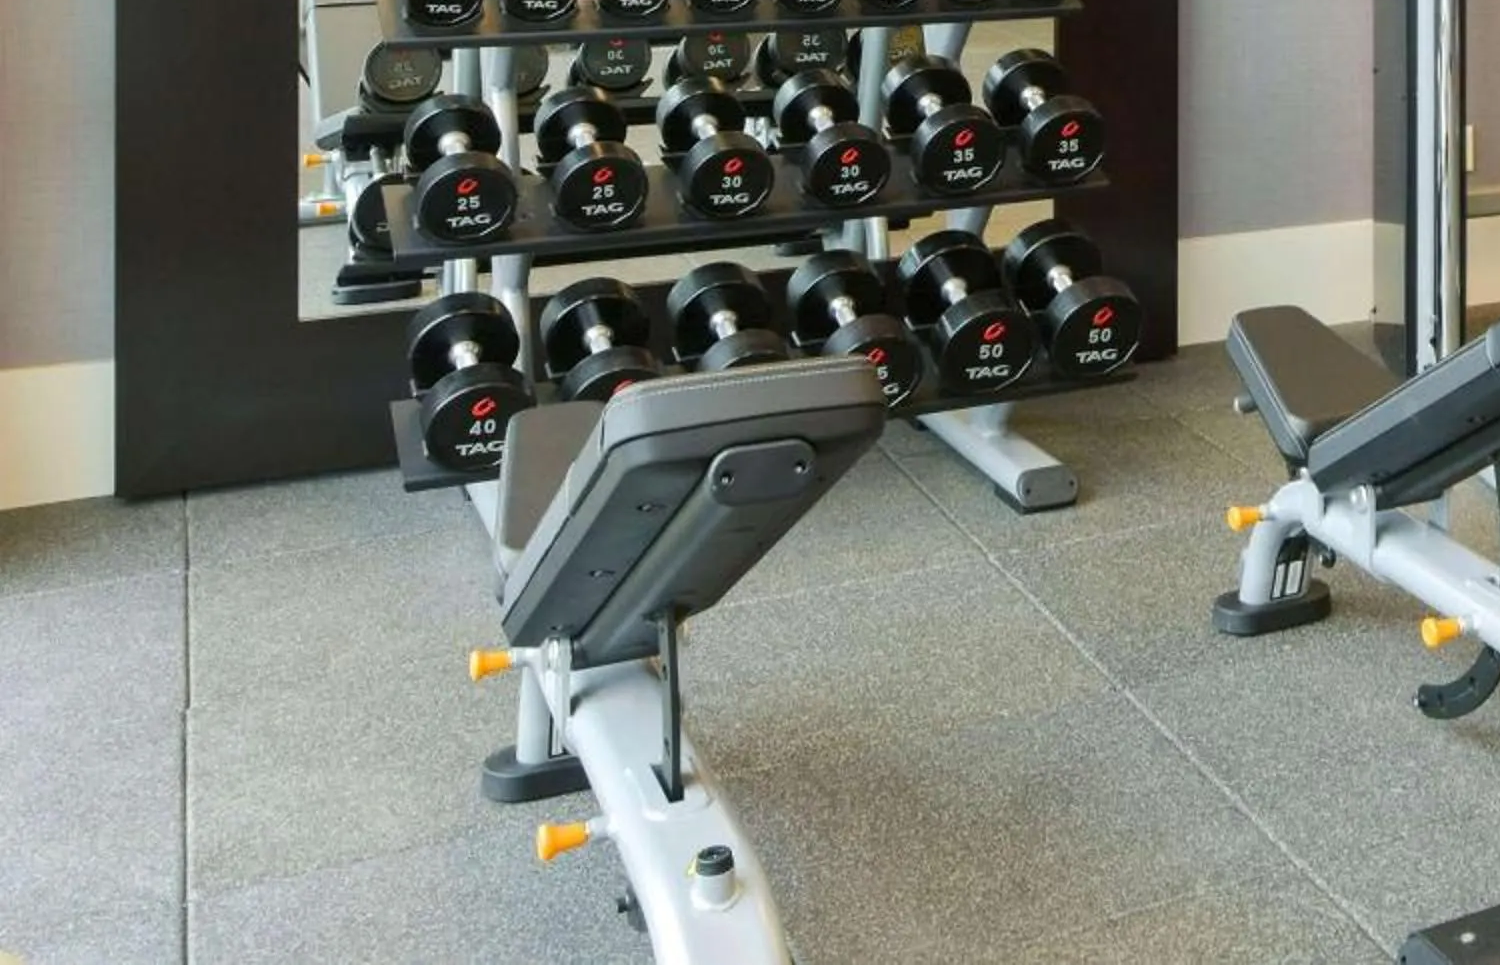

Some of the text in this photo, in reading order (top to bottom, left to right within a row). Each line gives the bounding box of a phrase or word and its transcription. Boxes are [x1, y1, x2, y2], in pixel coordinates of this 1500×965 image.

[426, 3, 463, 14] TAG
[523, 0, 559, 10] TAG
[1059, 138, 1080, 155] 35
[953, 147, 975, 163] 35
[1048, 157, 1086, 171] TAG
[841, 165, 860, 179] 30
[943, 166, 983, 182] TAG
[721, 175, 743, 189] 30
[831, 182, 869, 196] TAG
[592, 185, 614, 200] 25
[709, 192, 750, 206] TAG
[457, 196, 481, 211] 25
[581, 202, 625, 216] TAG
[447, 213, 491, 227] TAG
[1089, 328, 1112, 345] 50
[979, 343, 1004, 360] 50
[1075, 348, 1118, 364] TAG
[965, 364, 1011, 380] TAG
[469, 418, 497, 436] 40
